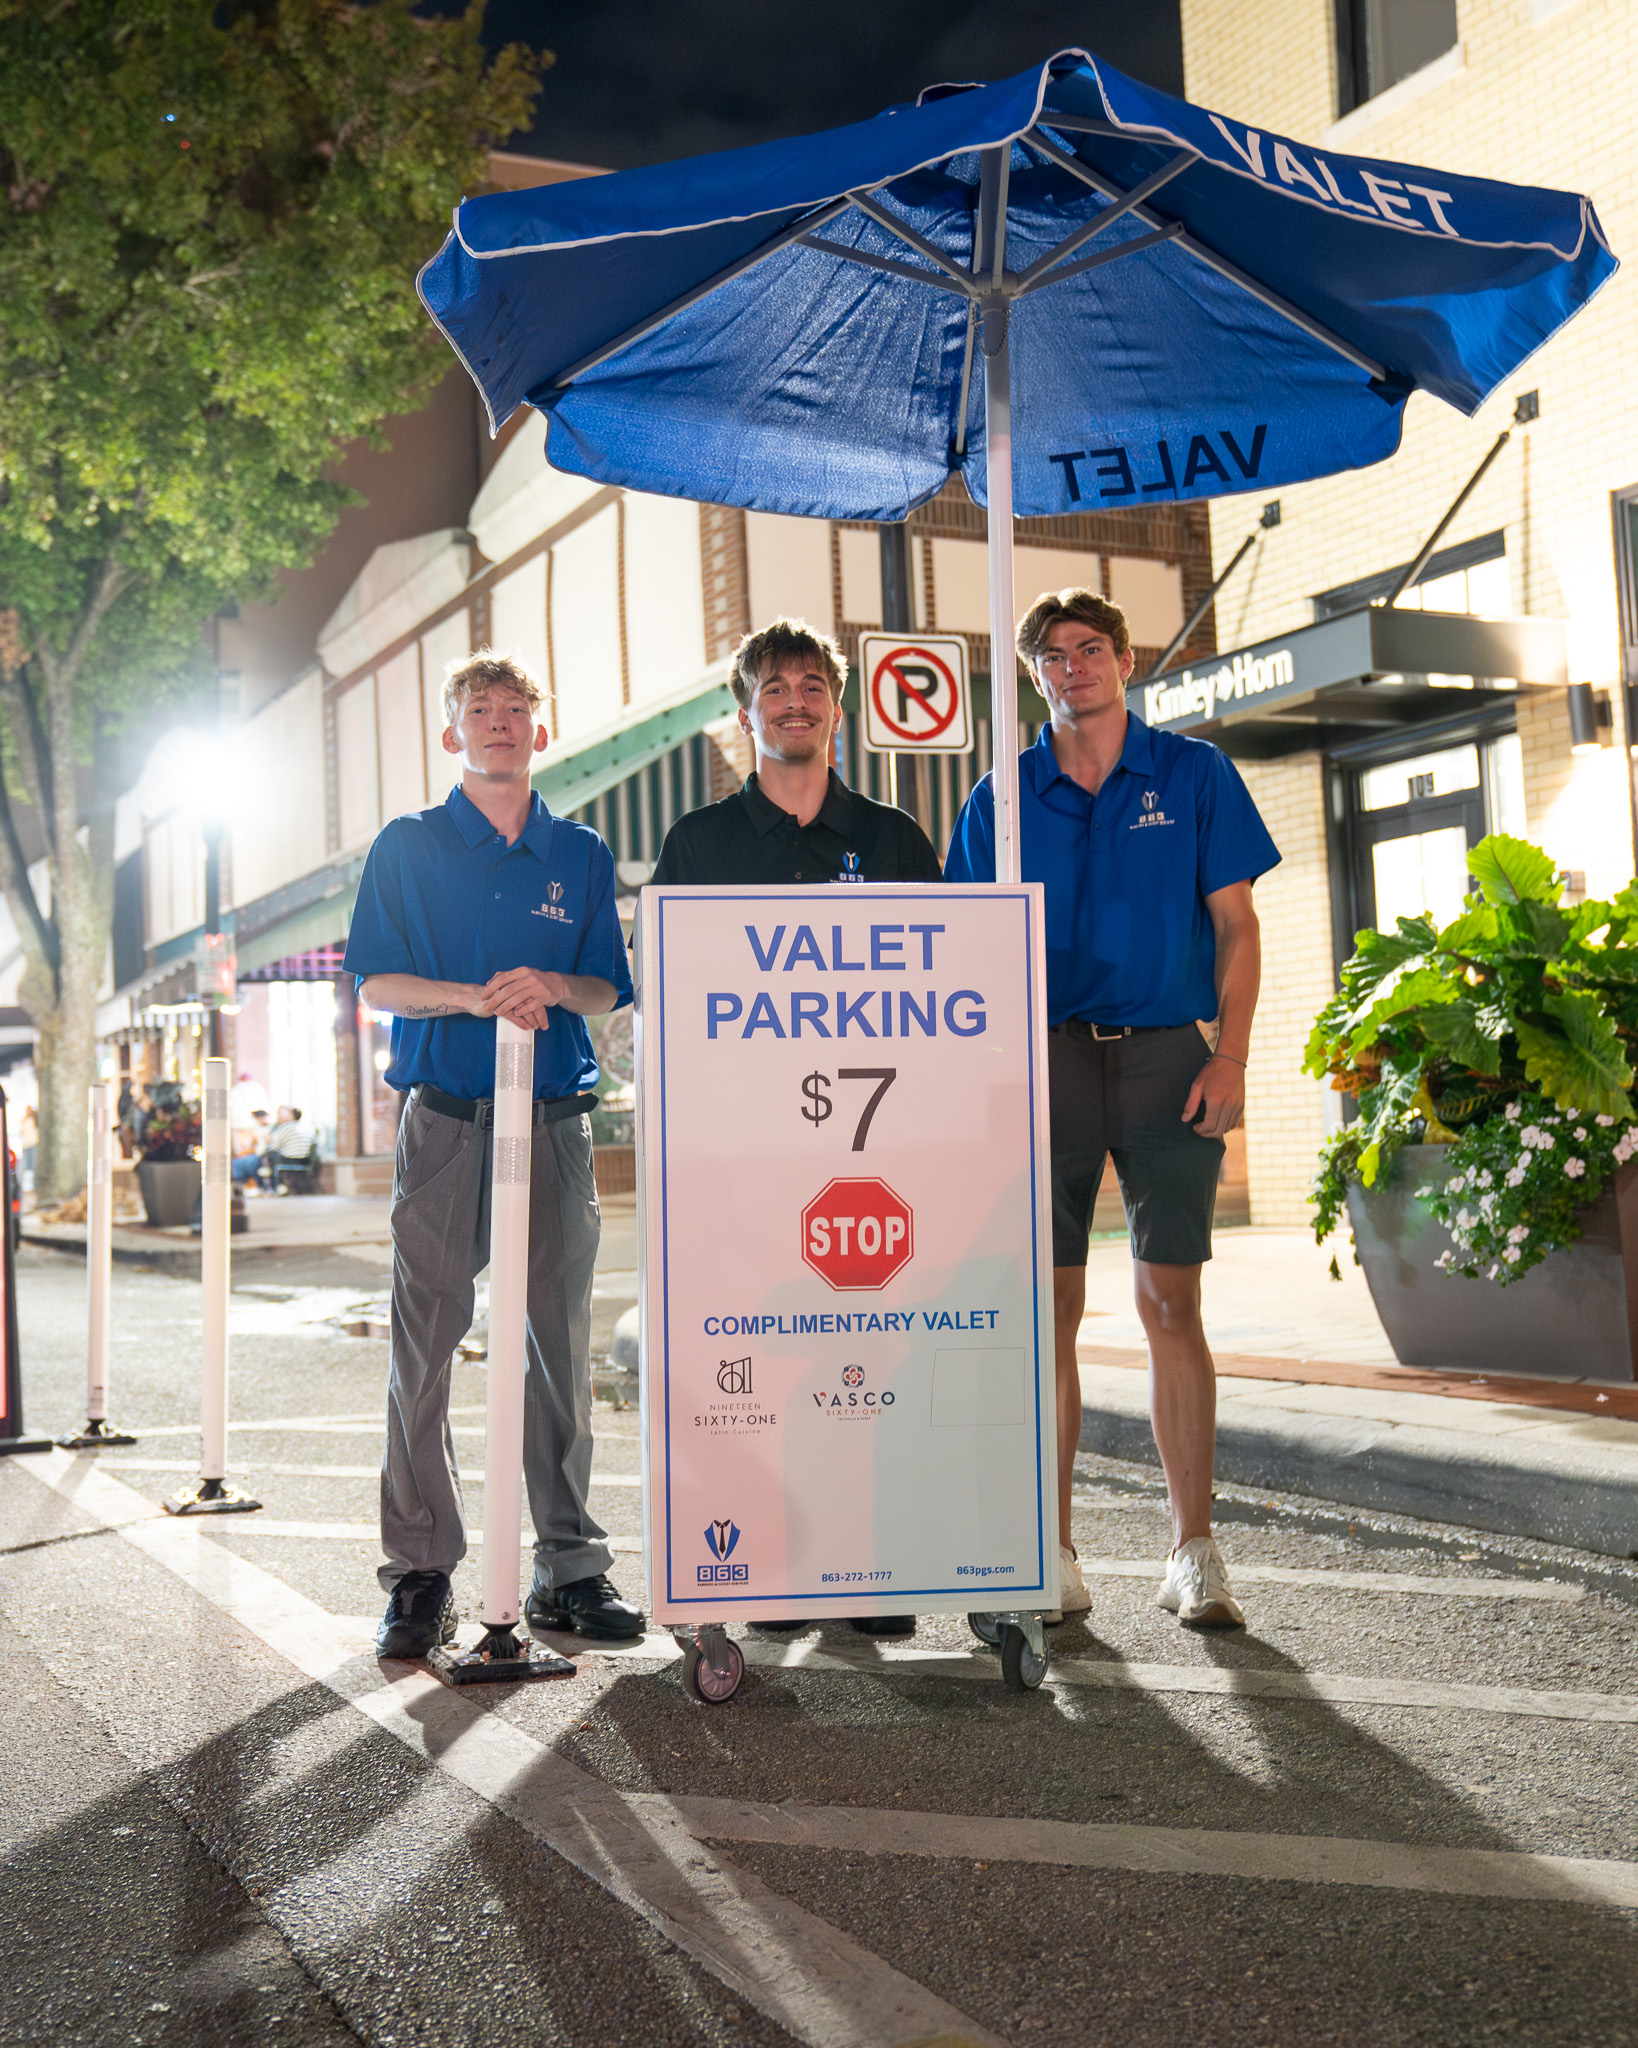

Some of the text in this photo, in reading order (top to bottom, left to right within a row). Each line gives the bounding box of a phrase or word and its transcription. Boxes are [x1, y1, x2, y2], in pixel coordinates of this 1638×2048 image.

[1208, 114, 1460, 237] VALET
[744, 924, 946, 972] VALET
[706, 989, 987, 1040] PARKING
[800, 1067, 897, 1152] $7
[809, 1216, 906, 1257] STOP
[703, 1310, 1000, 1336] COMPLIMENTARY VALET
[709, 1402, 761, 1411] NINETEEN
[812, 1391, 896, 1408] VASCO
[694, 1413, 777, 1427] SIXTY-ONE
[825, 1408, 882, 1416] SIXTY-ONE
[699, 1565, 747, 1581] 863
[821, 1571, 892, 1582] 863-272-1777
[956, 1565, 1015, 1576] 863pgs.com
